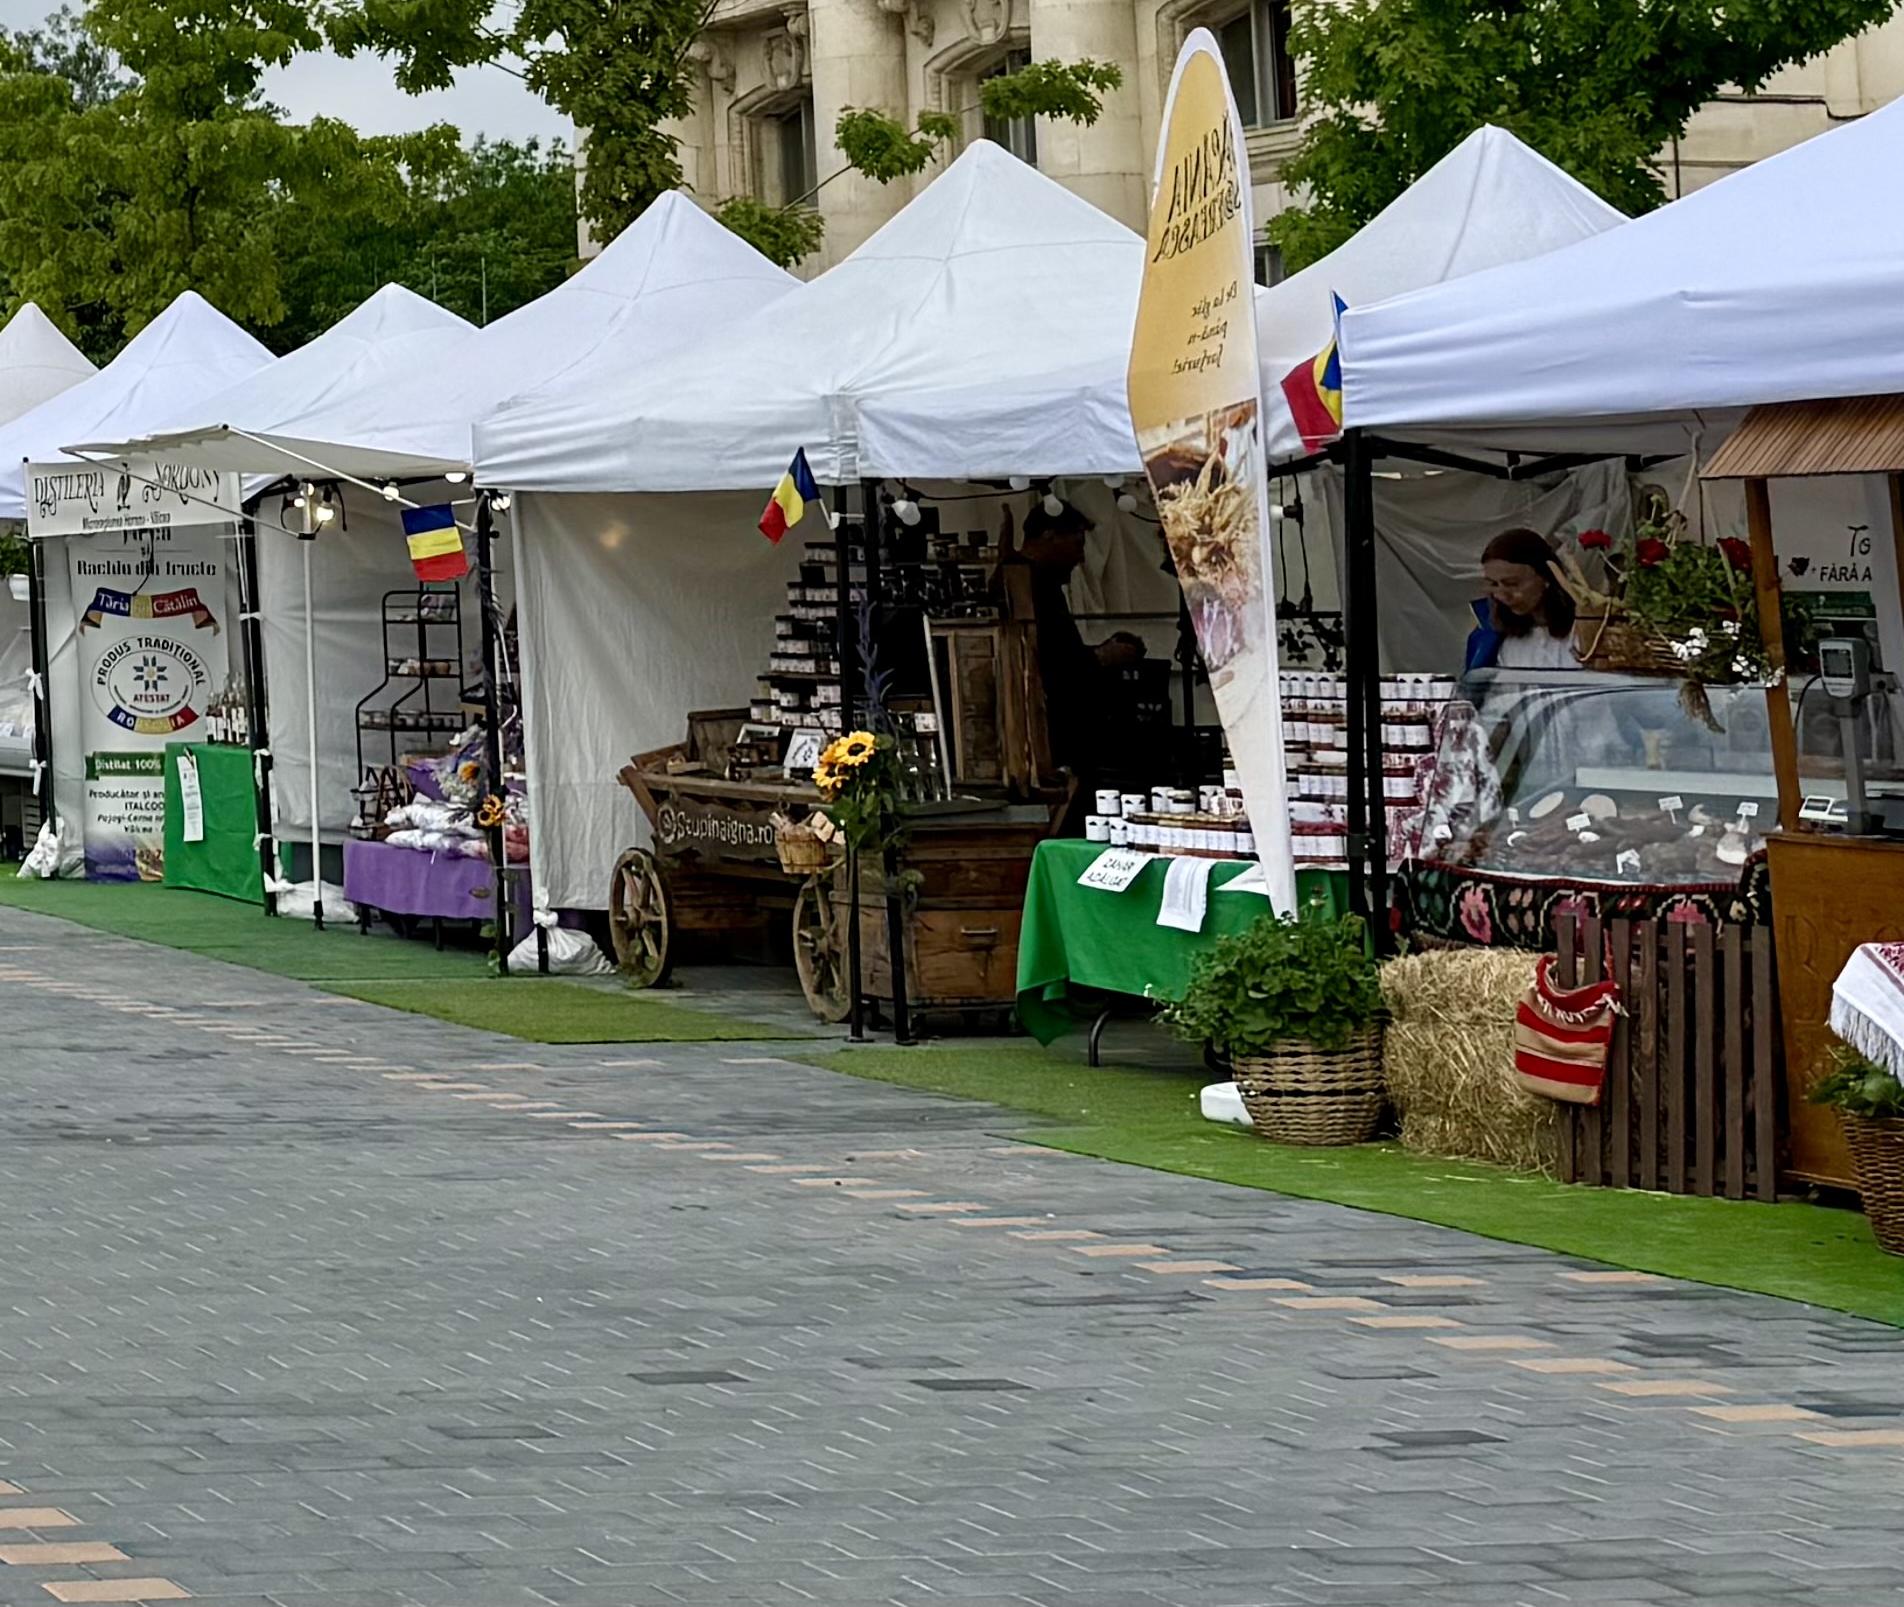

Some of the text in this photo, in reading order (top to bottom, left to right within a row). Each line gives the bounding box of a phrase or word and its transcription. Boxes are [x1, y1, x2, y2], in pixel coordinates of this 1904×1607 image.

[34, 471, 104, 518] DISTILERIA
[97, 640, 132, 686] PRODUS
[133, 694, 170, 703] ATESTAT
[135, 758, 162, 771] 100%
